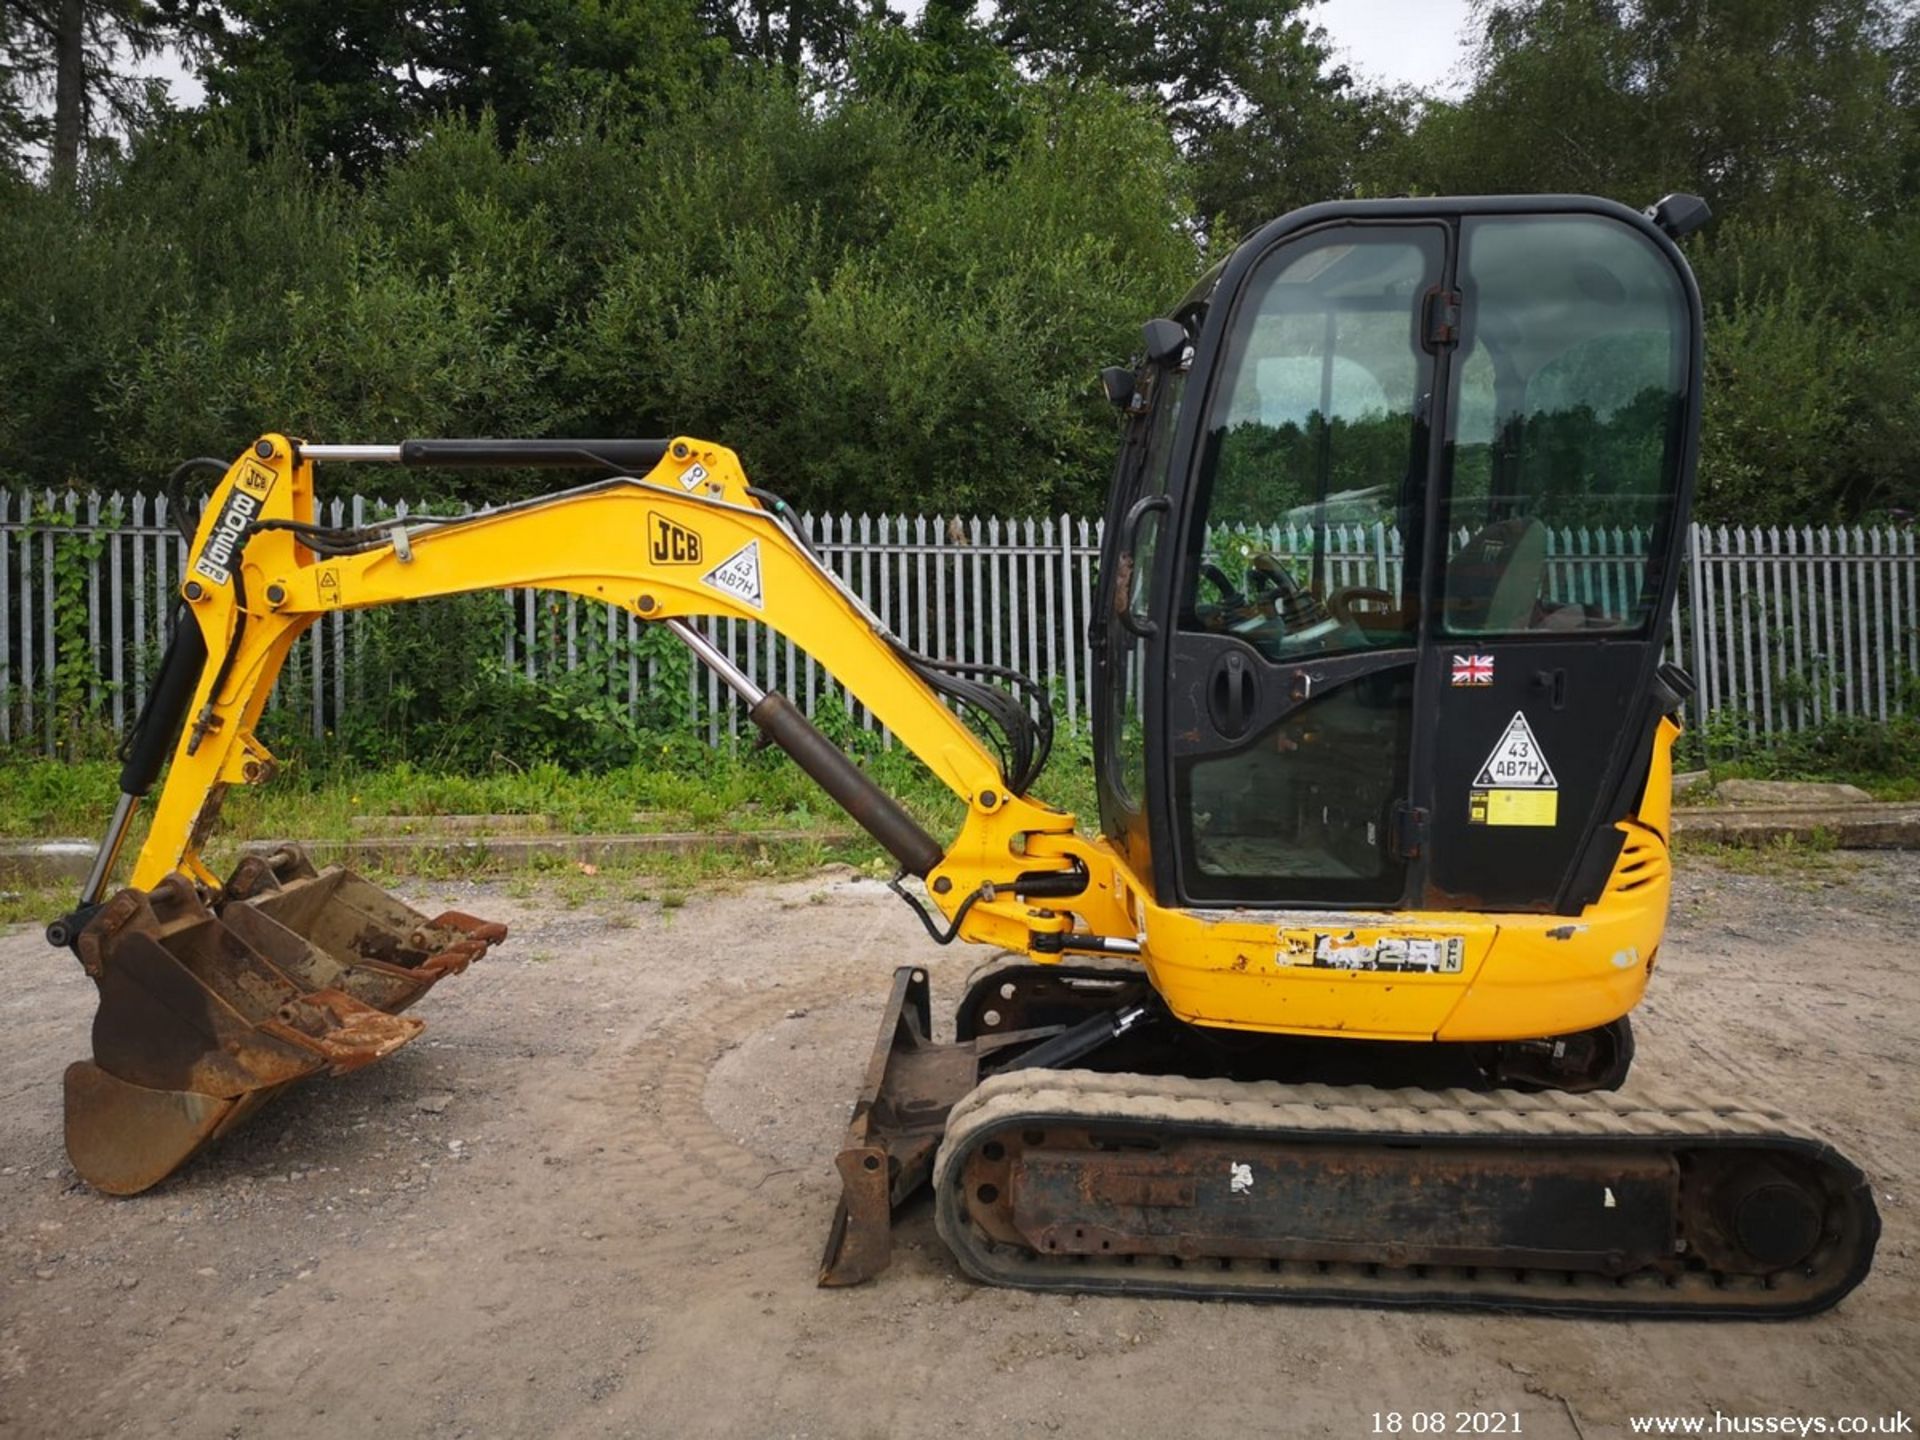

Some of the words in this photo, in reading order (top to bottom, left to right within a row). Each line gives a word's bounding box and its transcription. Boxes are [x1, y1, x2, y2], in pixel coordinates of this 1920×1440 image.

[246, 469, 267, 489] JCB
[208, 493, 255, 567] 8025
[654, 520, 698, 561] JCB
[199, 562, 226, 581] ZTS
[734, 561, 752, 576] 43
[718, 570, 754, 594] AB7H
[1508, 742, 1529, 758] 43
[1496, 761, 1539, 776] AB7H
[1447, 938, 1457, 968] ZTS
